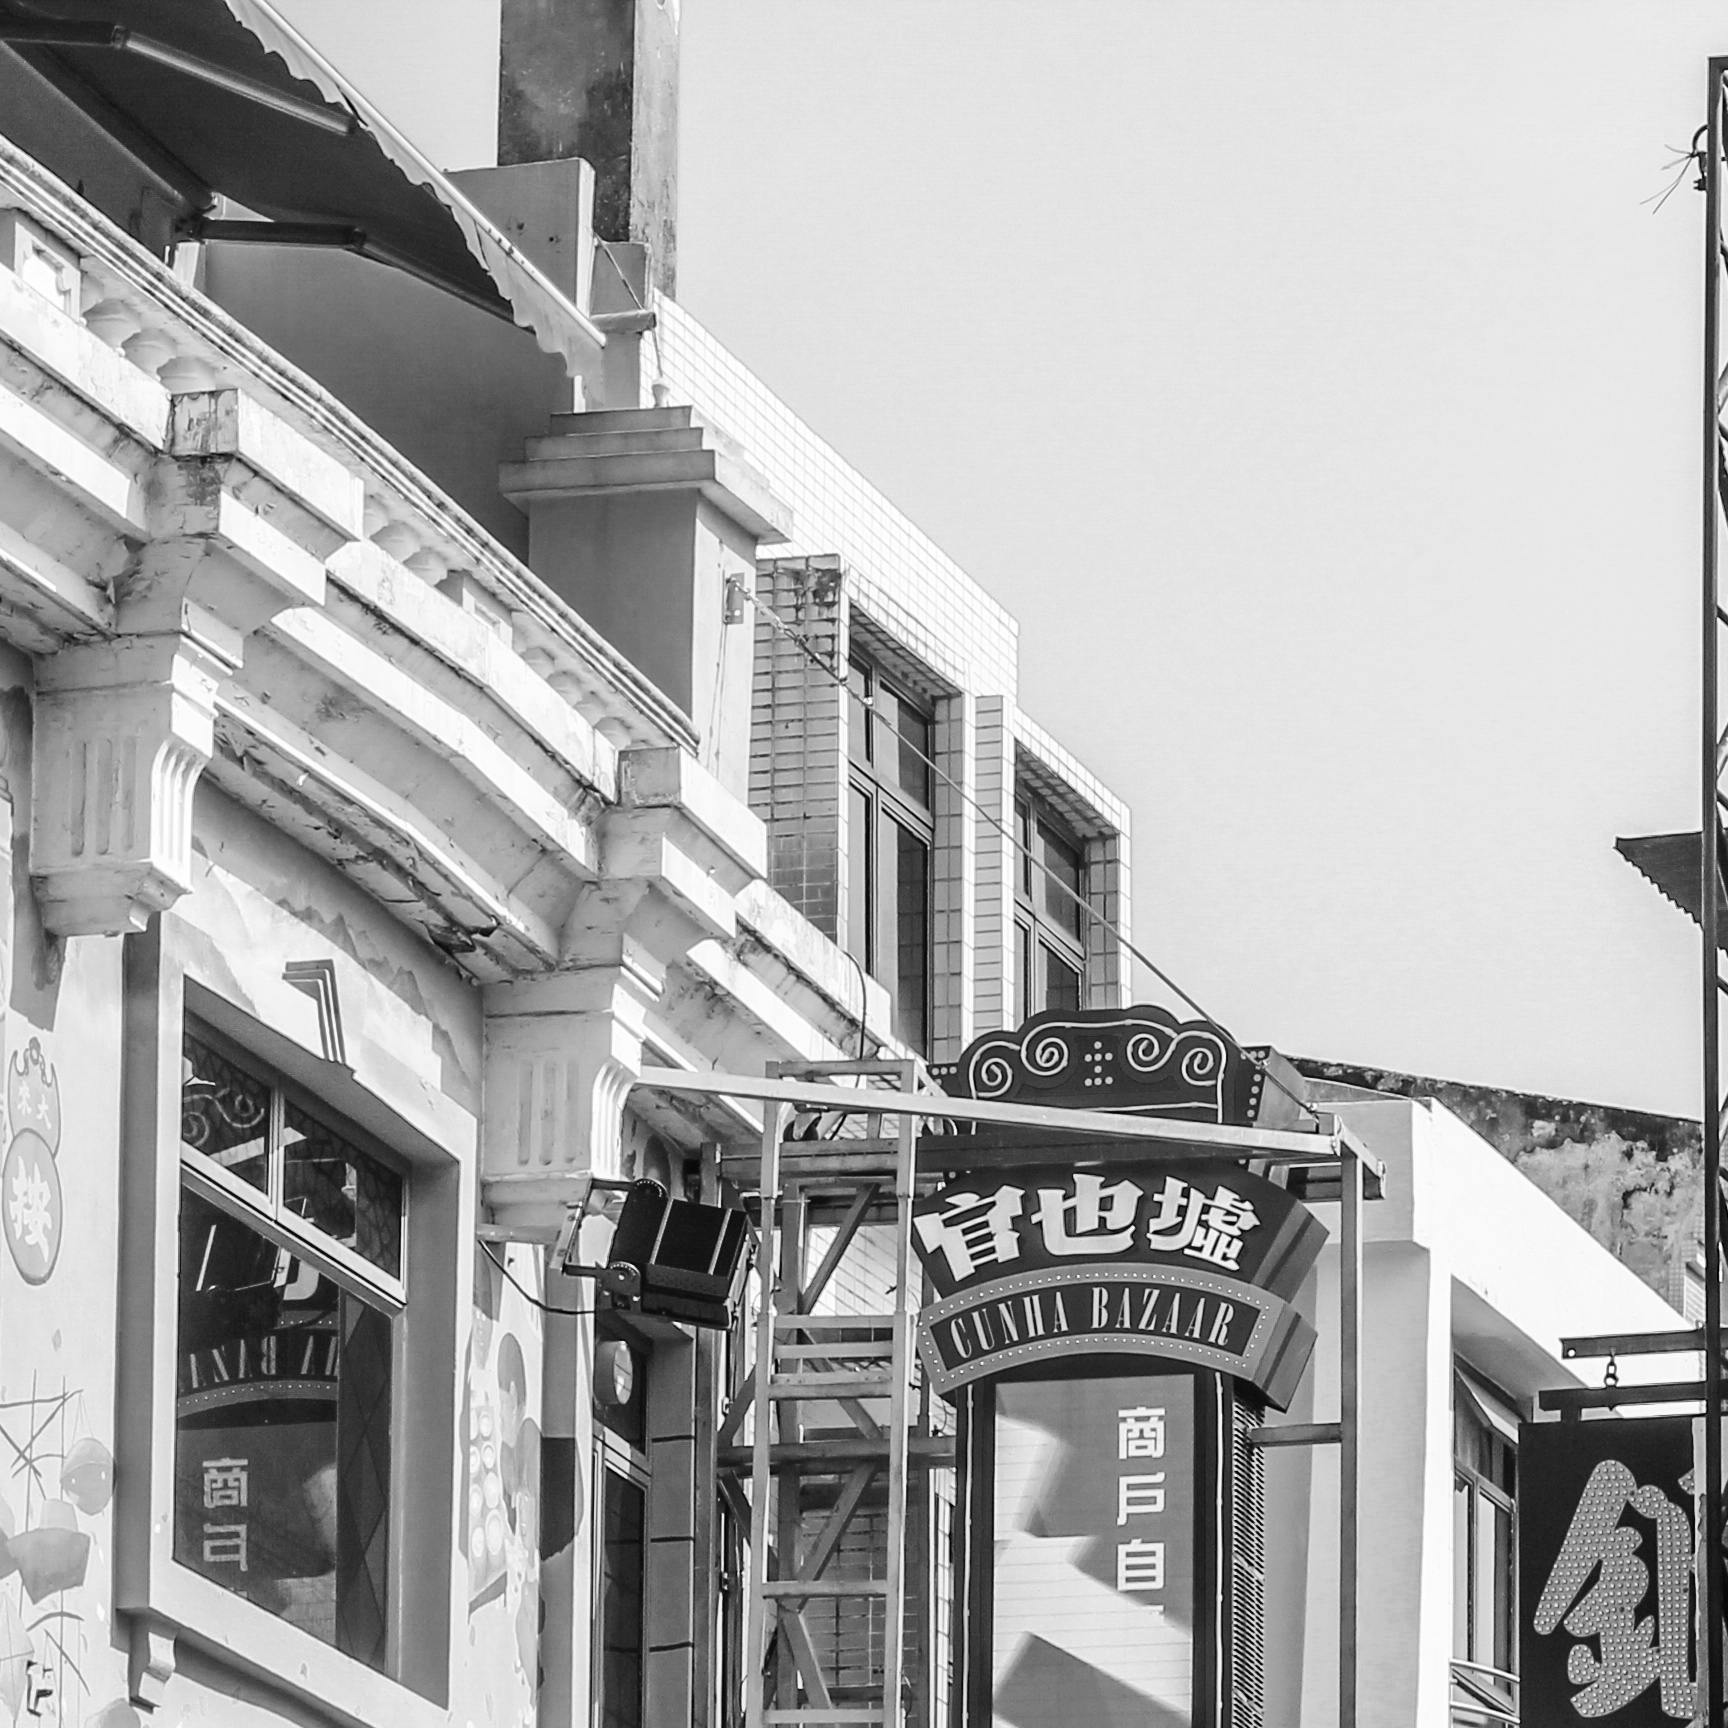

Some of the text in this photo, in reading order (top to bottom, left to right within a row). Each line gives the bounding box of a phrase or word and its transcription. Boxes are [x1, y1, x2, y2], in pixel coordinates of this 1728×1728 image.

[949, 1286, 1235, 1359] CUNHA BAZAAR
[1117, 1406, 1167, 1613] 商戶自
